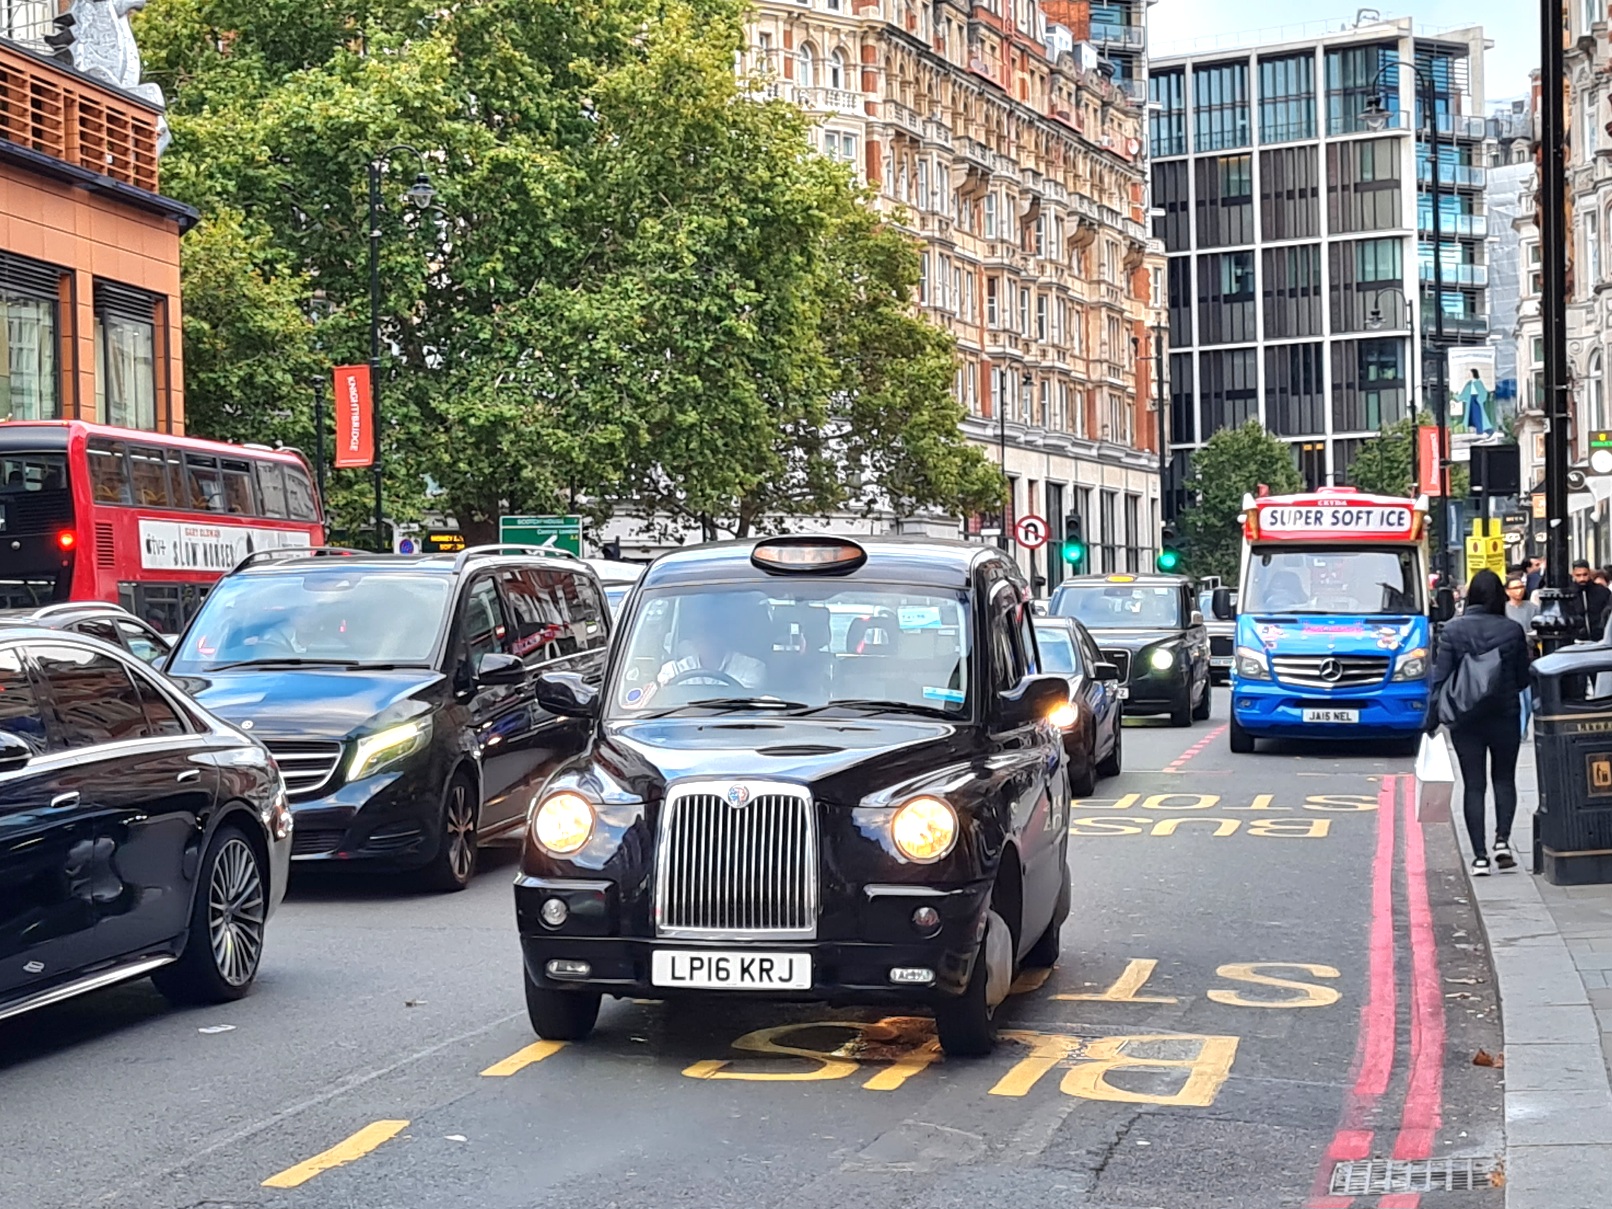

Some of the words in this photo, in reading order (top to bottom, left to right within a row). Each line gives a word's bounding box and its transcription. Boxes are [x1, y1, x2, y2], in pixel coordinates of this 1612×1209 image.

[1269, 509, 1324, 526] SUPER
[1330, 509, 1375, 526] SOFT
[1380, 510, 1406, 527] ICE
[172, 536, 200, 567] SLOW
[202, 541, 236, 568] HORSES
[1308, 708, 1331, 722] JA15
[1333, 709, 1353, 722] NEL
[1070, 816, 1332, 838] BUS
[670, 955, 731, 982] LP16
[740, 957, 794, 983] KRJ
